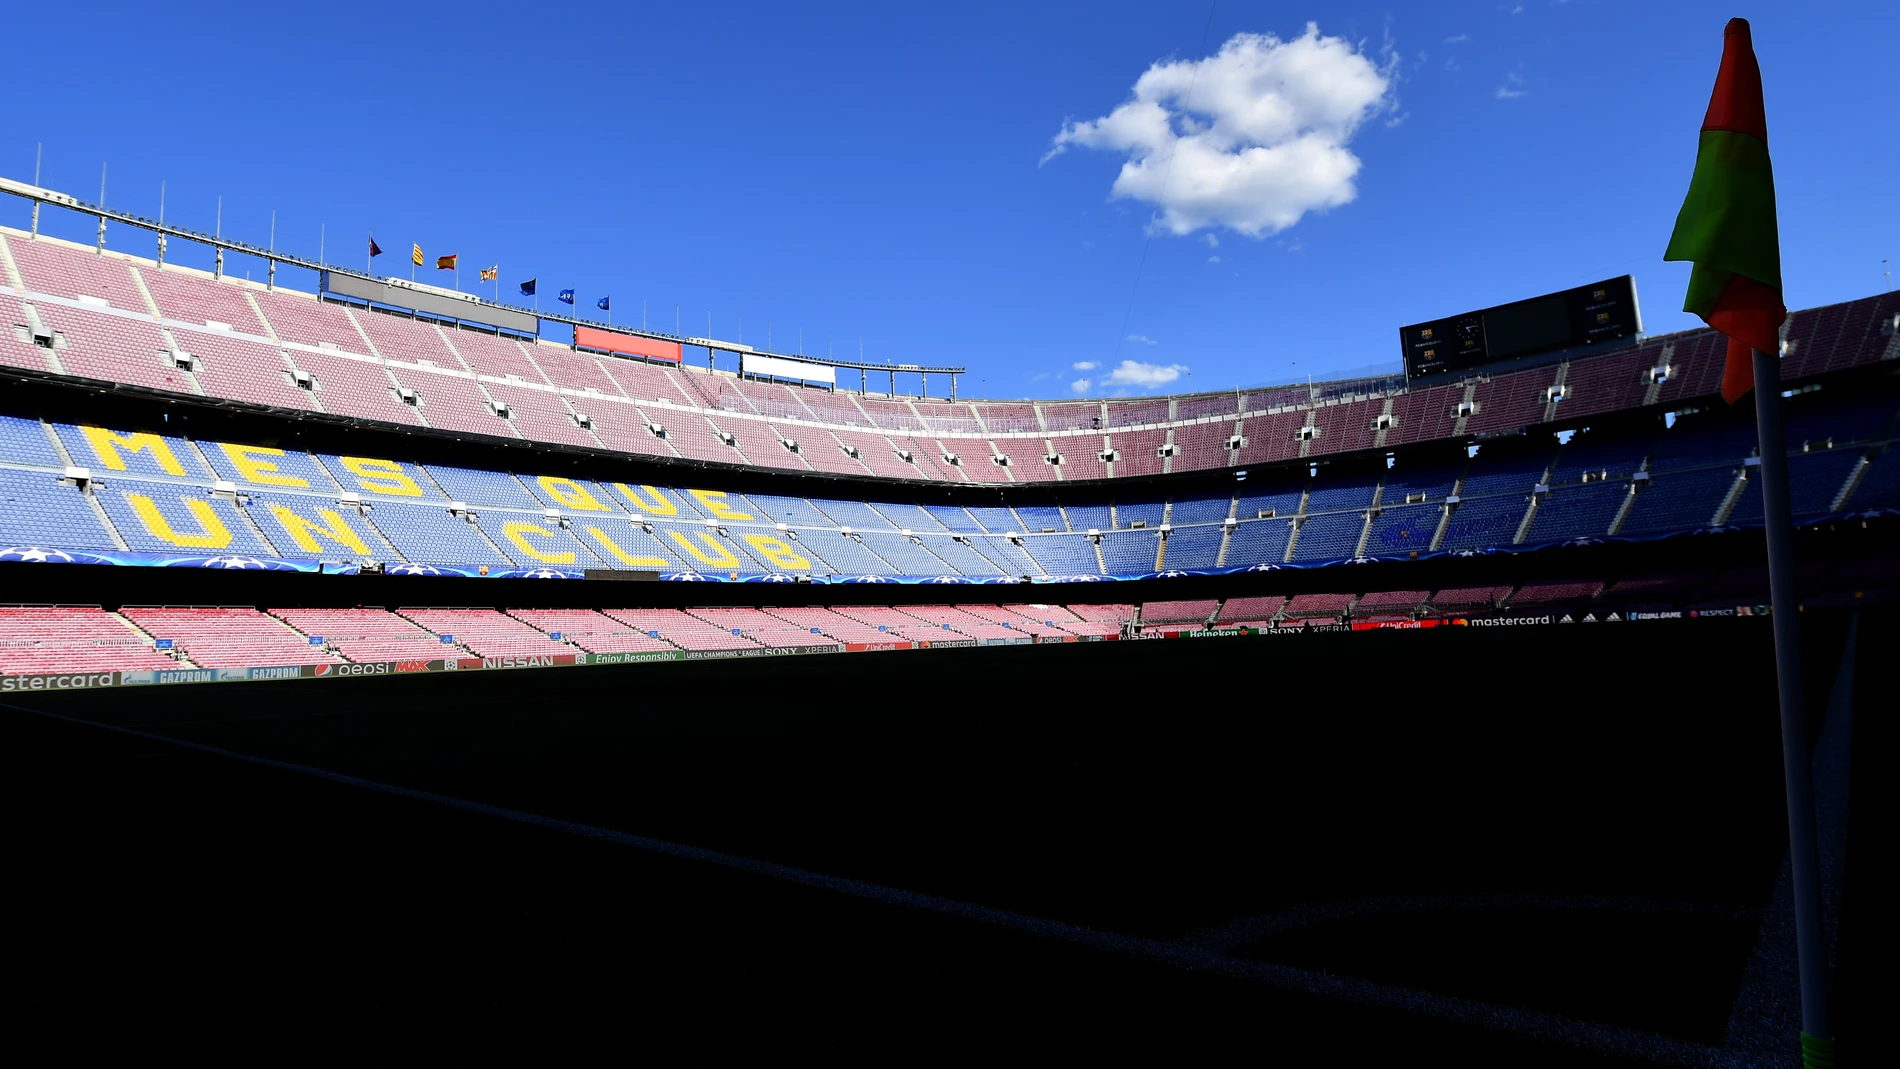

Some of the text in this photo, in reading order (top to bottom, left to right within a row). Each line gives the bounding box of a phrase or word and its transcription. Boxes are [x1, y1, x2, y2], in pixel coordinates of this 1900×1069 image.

[537, 475, 754, 521] QUE
[128, 494, 811, 571] UN CLUB
[1699, 609, 1734, 617] RESPECT
[1471, 615, 1550, 627] mastercard
[1189, 630, 1238, 638] Heineken
[1269, 627, 1304, 635] SONY
[764, 645, 837, 656] SONY XPERIA
[932, 640, 976, 649] mastercard
[686, 651, 703, 659] UEFA
[703, 650, 738, 658] CHAMPIONS
[339, 659, 431, 676] pepsi MAX
[482, 655, 554, 669] NISSAN
[160, 671, 211, 683] GAZPROM
[252, 667, 298, 679] GAZPROM
